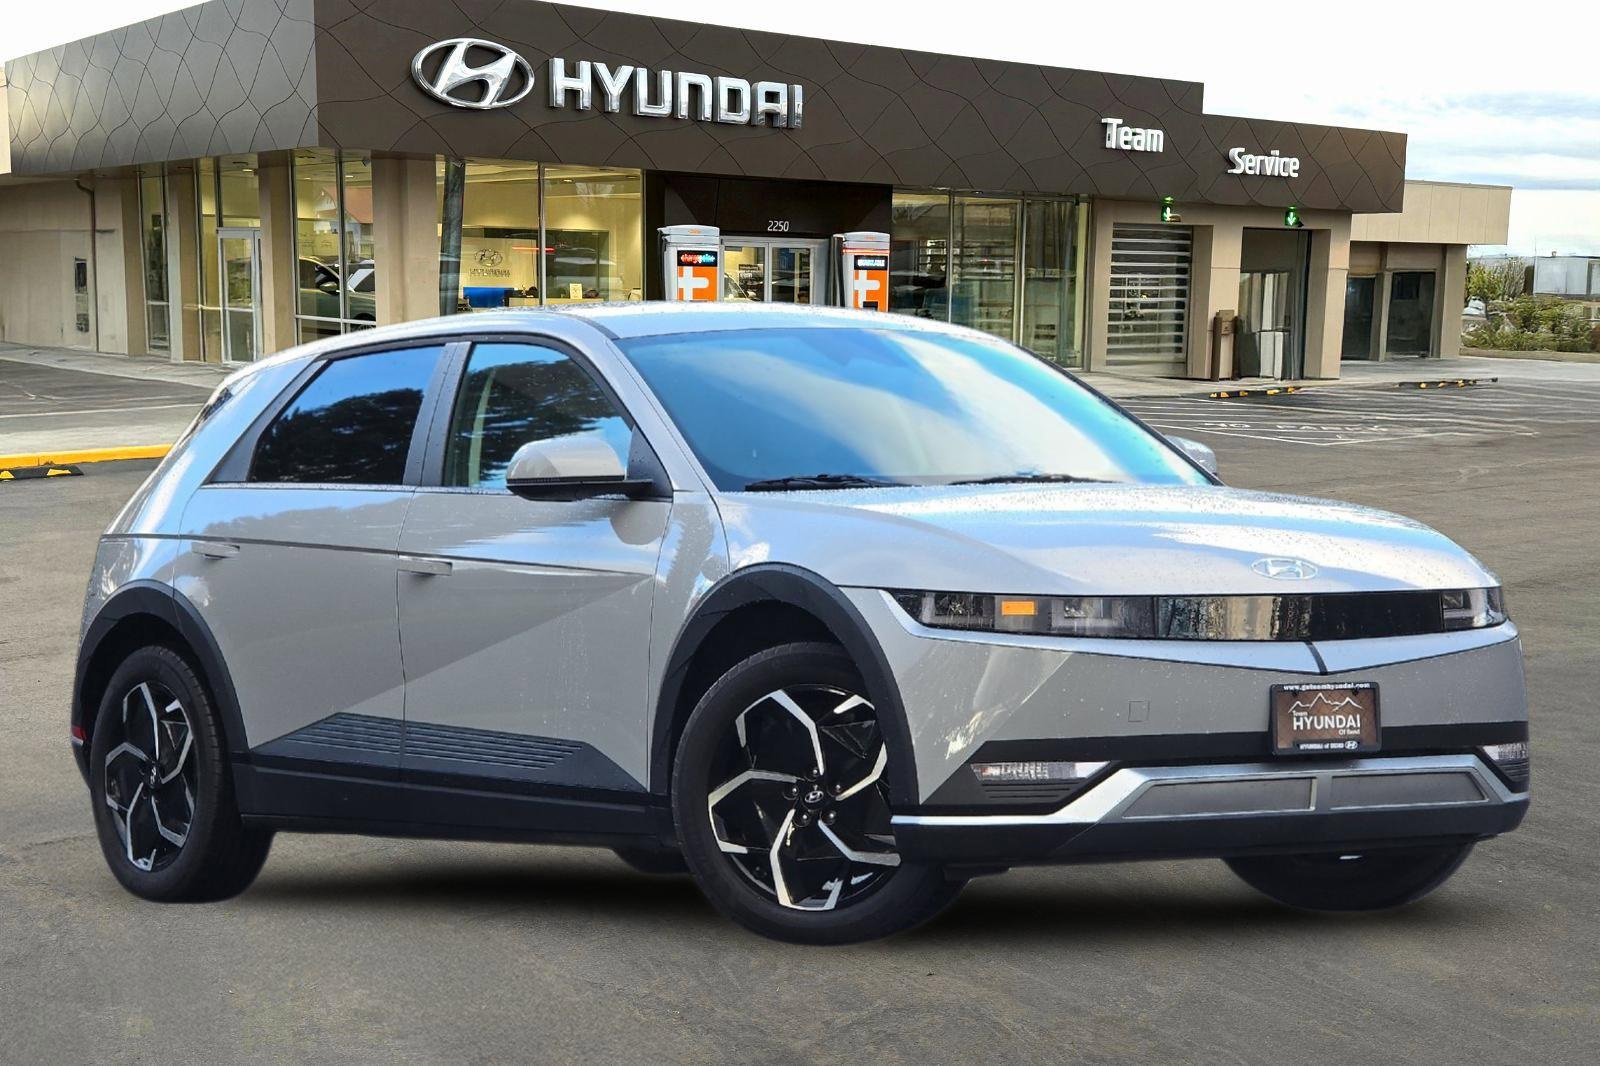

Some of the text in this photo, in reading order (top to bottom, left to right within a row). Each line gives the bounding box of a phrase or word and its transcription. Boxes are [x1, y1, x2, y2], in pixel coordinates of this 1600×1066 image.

[548, 57, 803, 129] HYUNDAI
[1101, 117, 1164, 153] Team
[1227, 147, 1300, 178] Service
[767, 220, 790, 232] 2250
[1293, 714, 1360, 730] HYUNDAI
